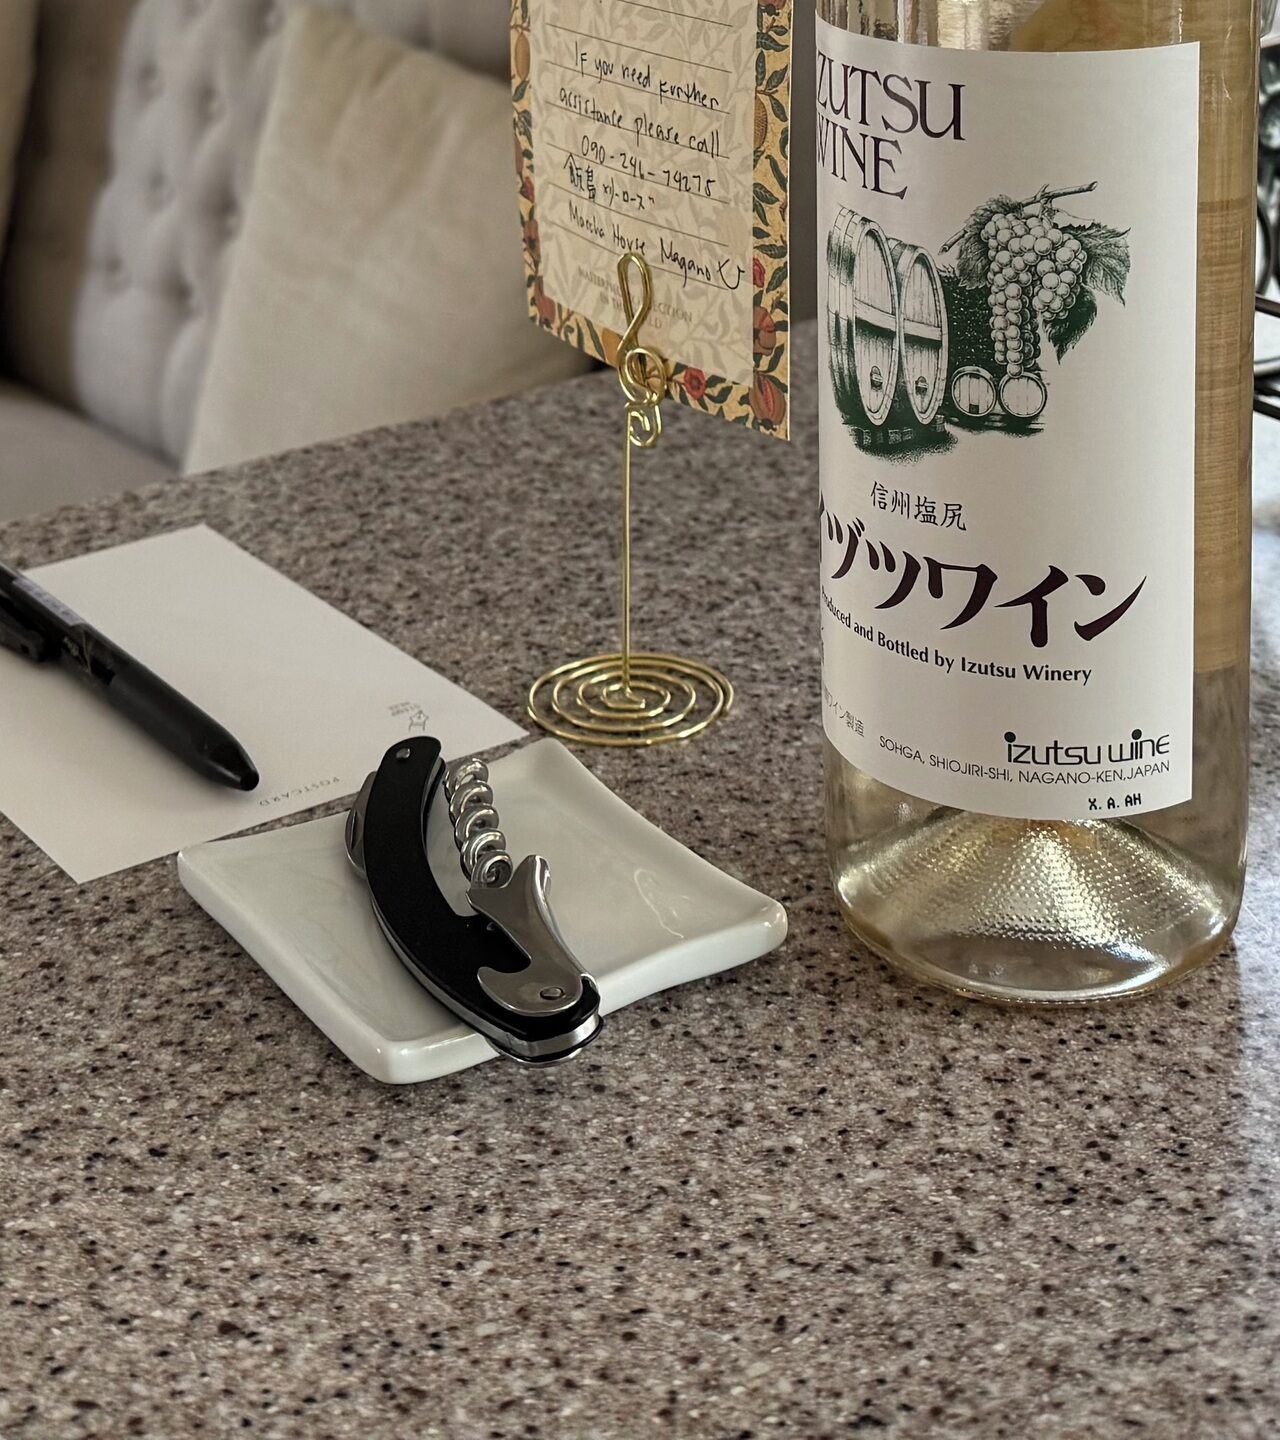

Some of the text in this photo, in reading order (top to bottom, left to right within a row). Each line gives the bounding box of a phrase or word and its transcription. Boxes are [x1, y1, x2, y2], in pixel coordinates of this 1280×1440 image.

[595, 58, 614, 84] you
[621, 64, 651, 89] need
[560, 88, 720, 159] assistance please call
[818, 112, 908, 200] WINE
[612, 223, 646, 255] House
[659, 237, 712, 288] Nagano
[870, 481, 967, 532] 信州塩尻
[820, 490, 1147, 648] ヅツワイン
[853, 621, 874, 642] and
[877, 631, 929, 663] Bottled
[934, 650, 954, 674] by
[961, 656, 1017, 680] Izutsu
[1023, 663, 1092, 686] Winery
[879, 735, 926, 765] SOHGA,
[929, 754, 1013, 783] SHIOJIRI-SHI,
[1004, 728, 1170, 766] izutsu wine
[1107, 796, 1120, 809] A.
[1124, 793, 1142, 807] AH
